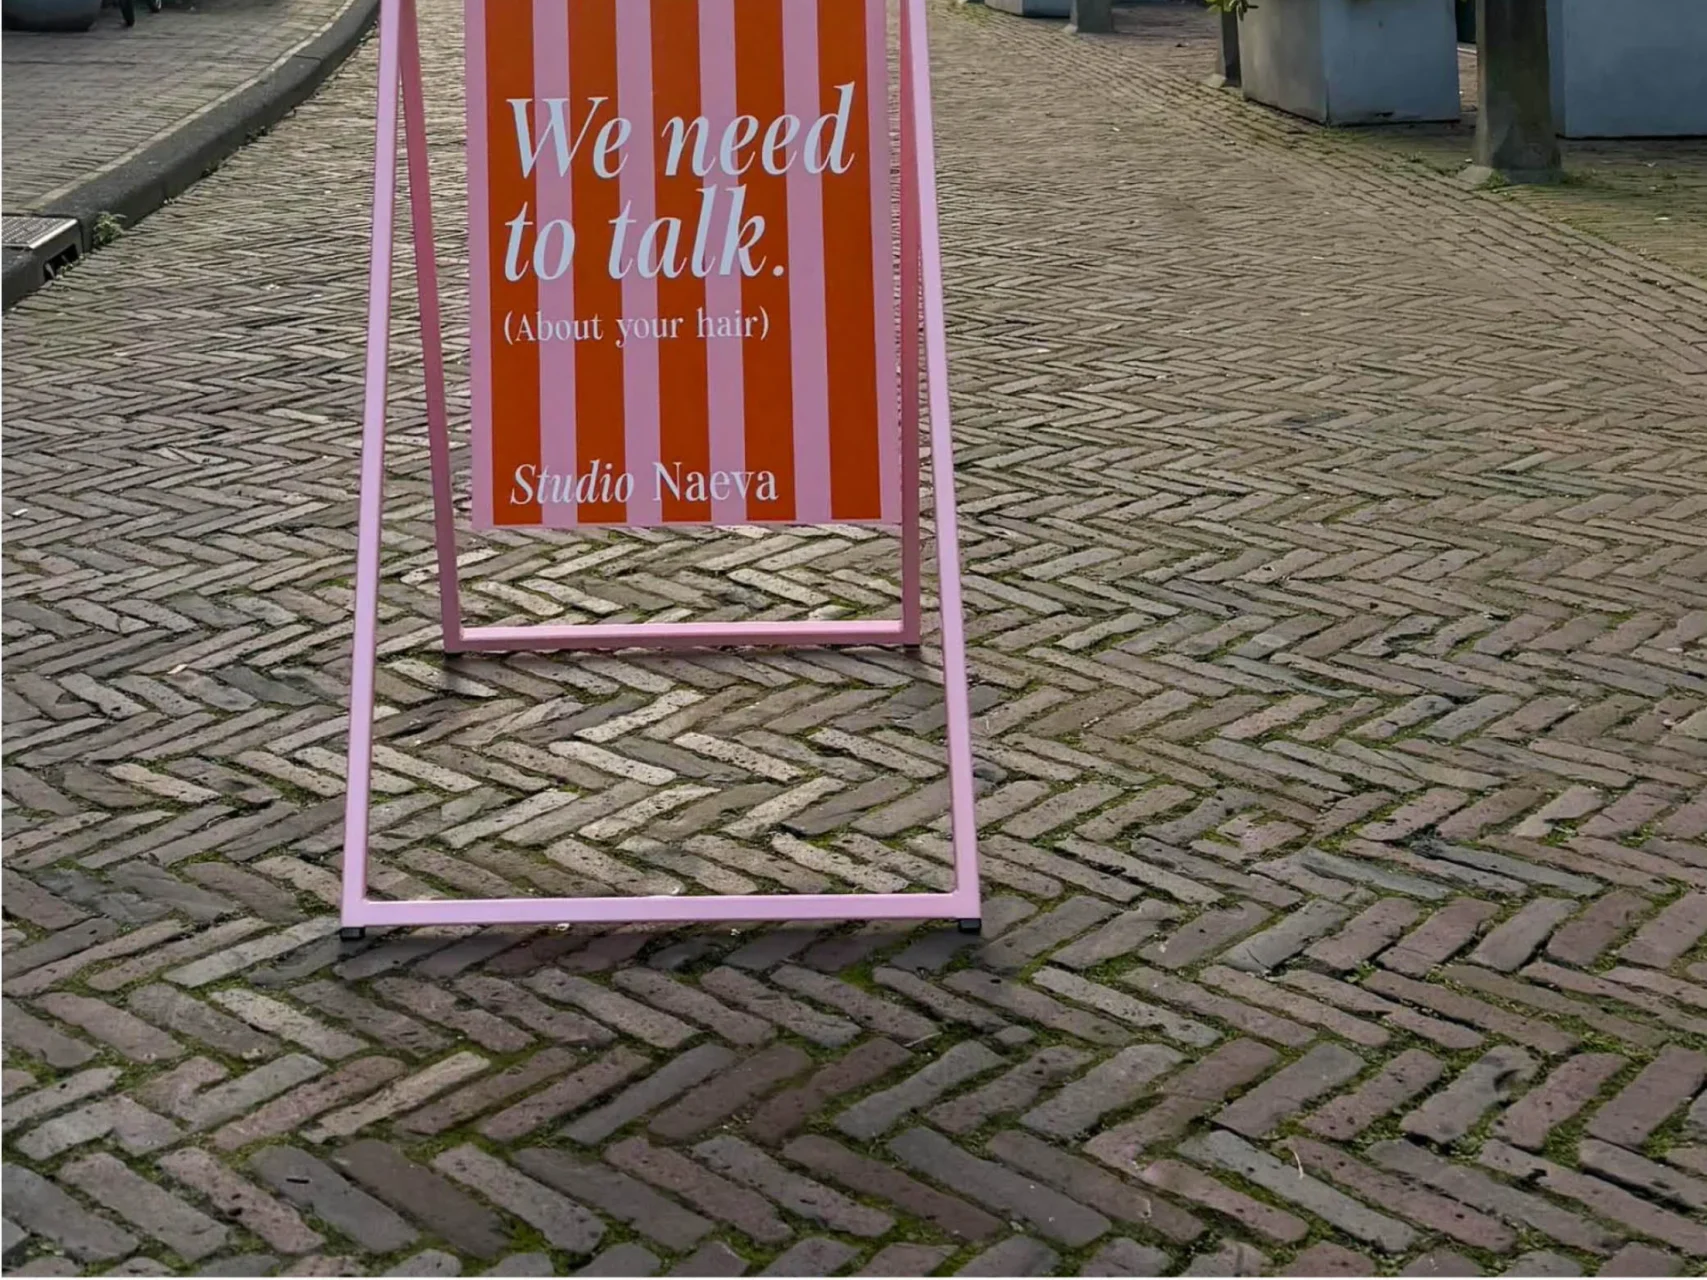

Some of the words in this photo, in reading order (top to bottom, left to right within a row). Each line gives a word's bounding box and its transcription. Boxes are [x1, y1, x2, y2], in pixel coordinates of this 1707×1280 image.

[507, 97, 631, 178] We
[663, 82, 854, 177] need
[505, 203, 575, 281] to
[609, 184, 783, 279] talk.
[504, 310, 602, 342] (About
[616, 318, 683, 346] your
[698, 307, 769, 340] hair)
[511, 459, 634, 505] Studio
[653, 461, 777, 502] Naeva
